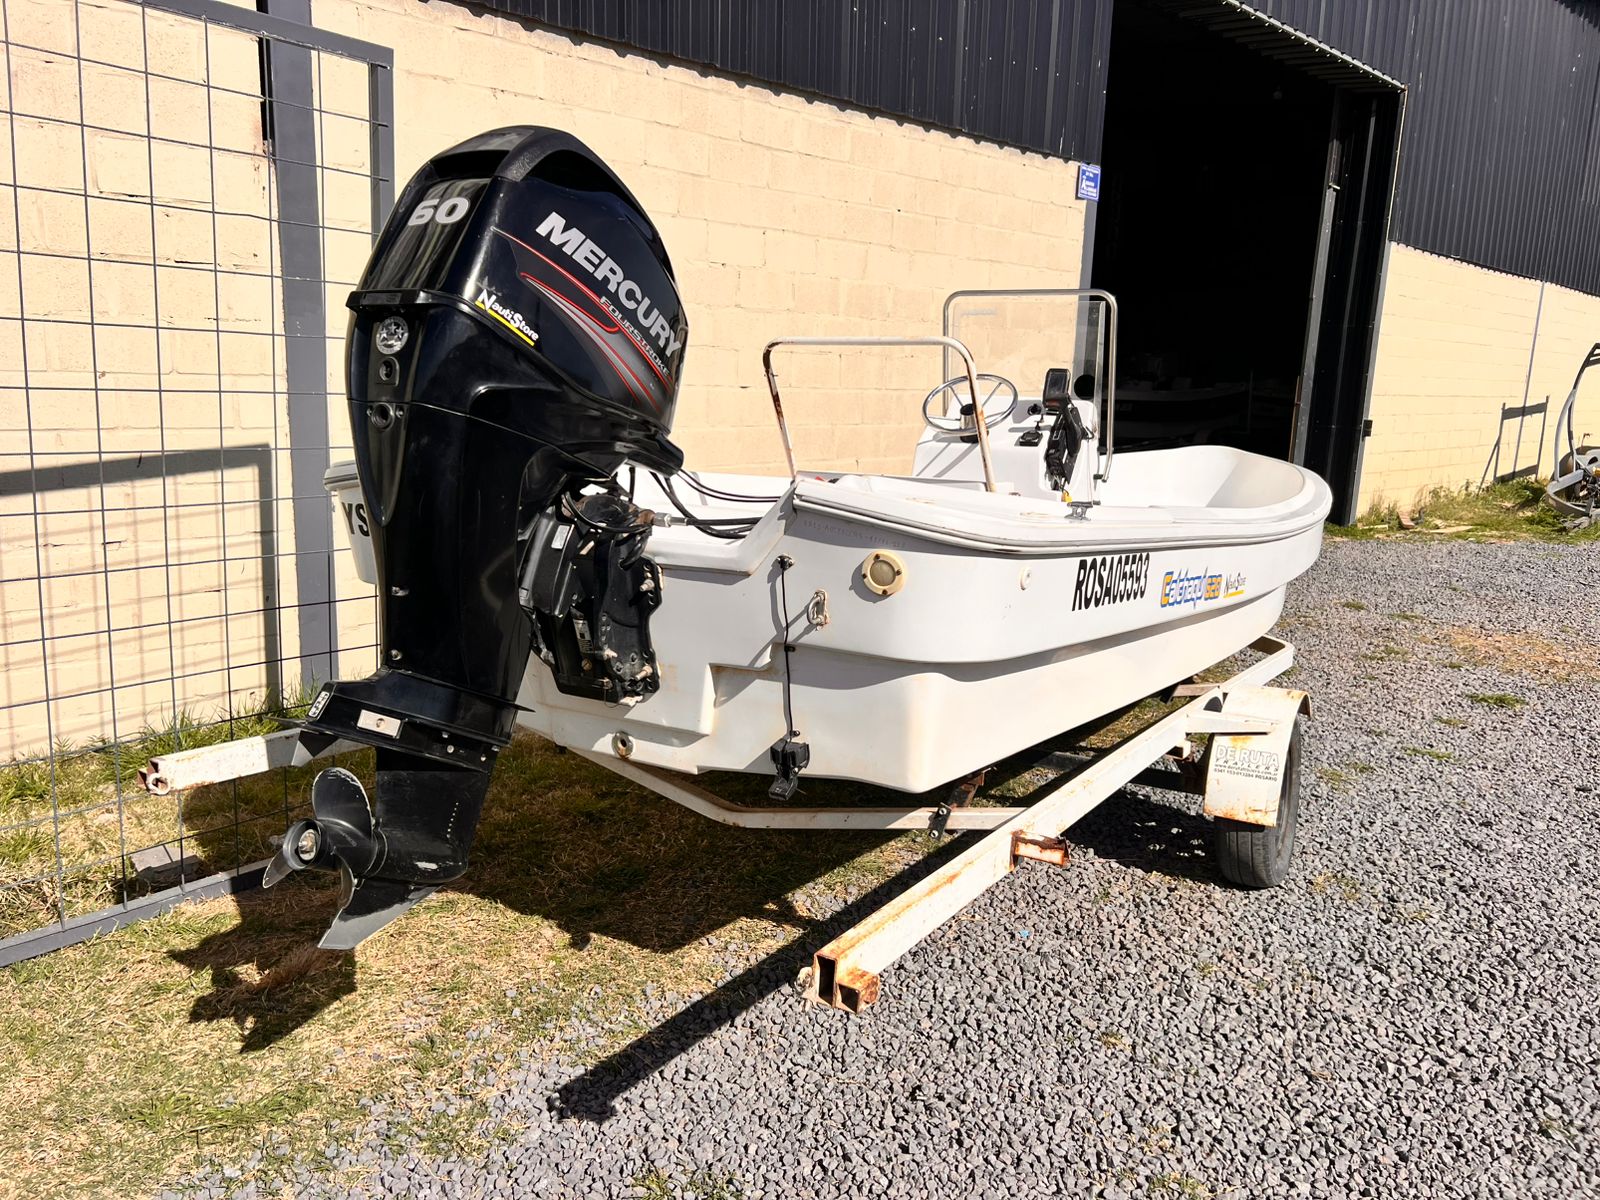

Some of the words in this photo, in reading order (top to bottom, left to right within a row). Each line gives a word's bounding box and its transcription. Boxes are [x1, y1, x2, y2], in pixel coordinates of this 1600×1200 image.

[477, 288, 539, 341] NautiStore
[535, 211, 682, 358] MERCURY
[600, 295, 670, 376] FOURSTROKE
[1071, 552, 1150, 612] ROSA05593
[1216, 745, 1236, 761] DE
[1239, 748, 1279, 769] RUTA
